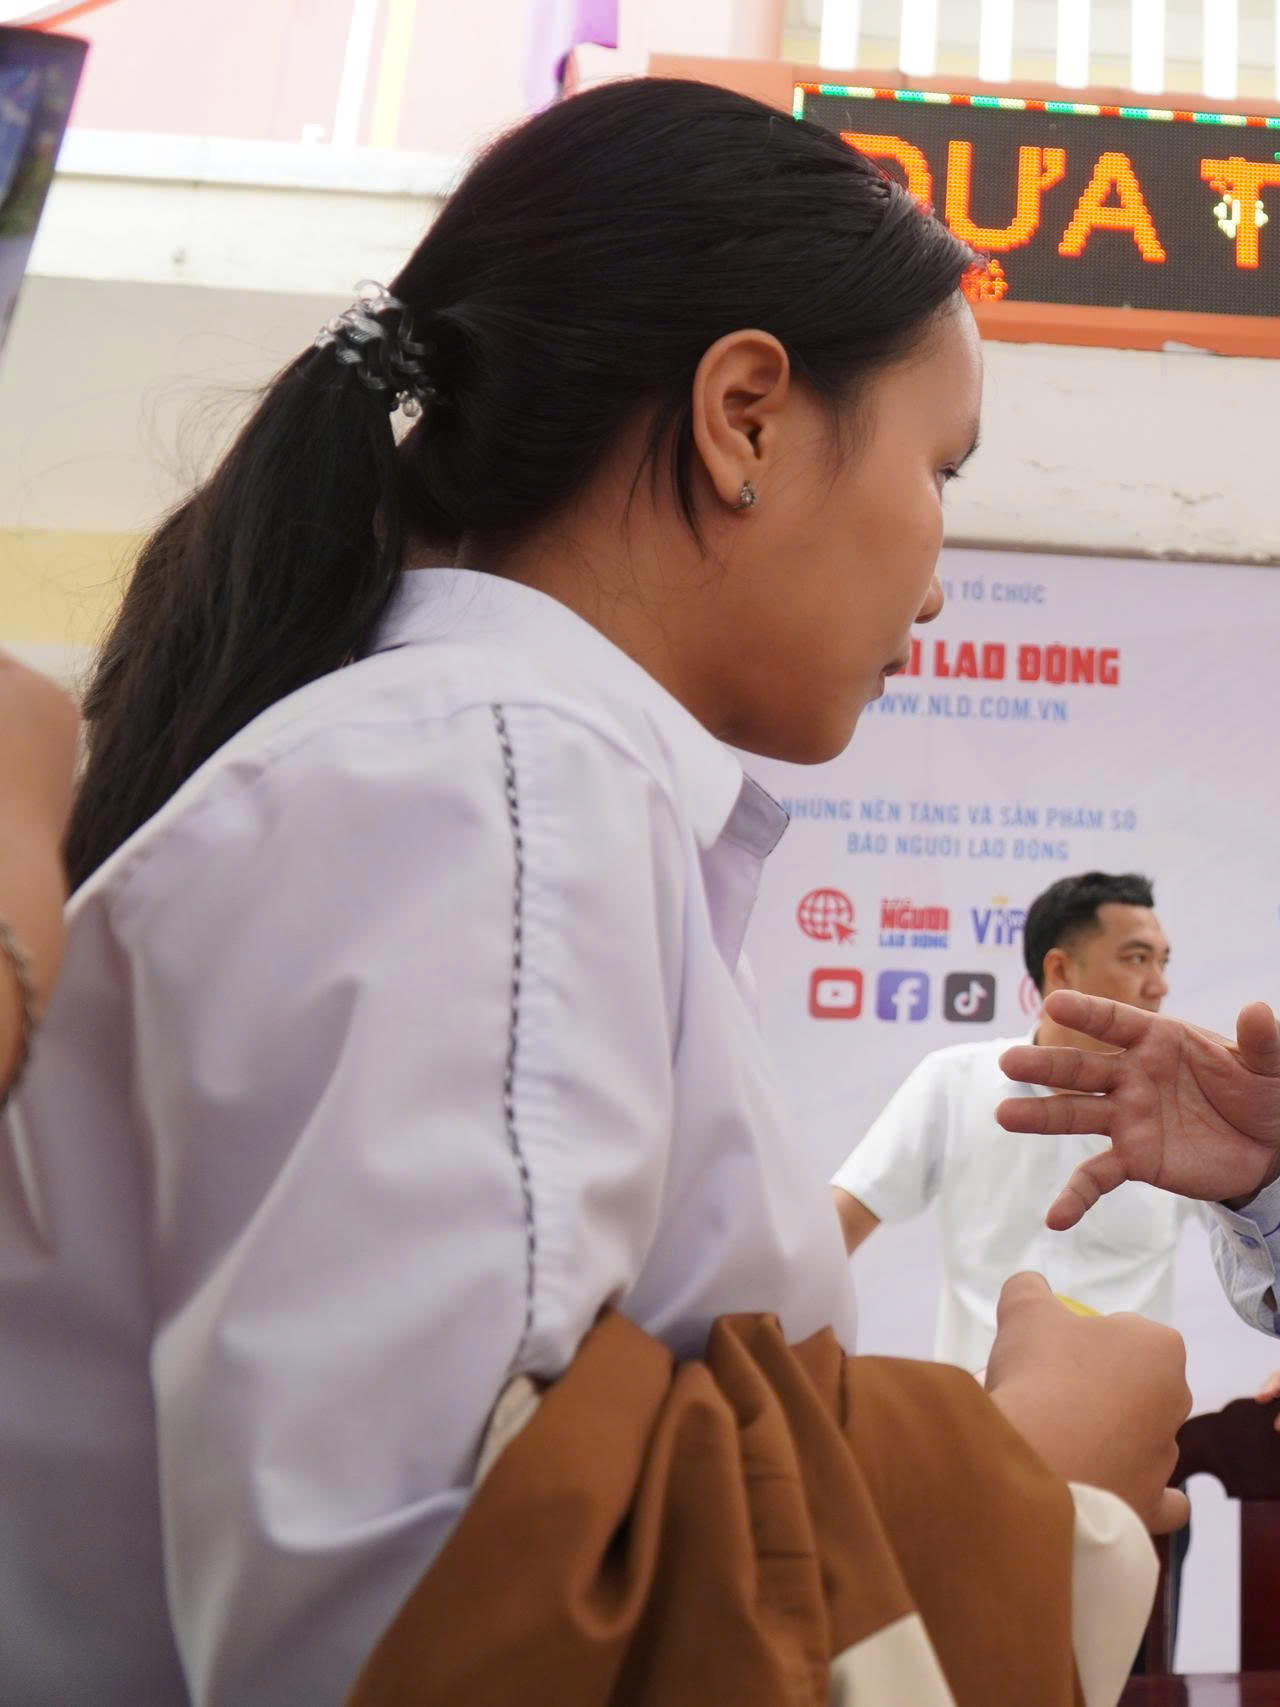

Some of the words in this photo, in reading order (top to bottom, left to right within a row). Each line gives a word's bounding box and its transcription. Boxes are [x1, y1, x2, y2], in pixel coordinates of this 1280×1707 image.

[934, 640, 1006, 681] LAO
[1018, 642, 1119, 687] ĐỘNG
[867, 693, 1069, 721] WW.NLD.COM.VN
[967, 835, 1006, 860] LAO
